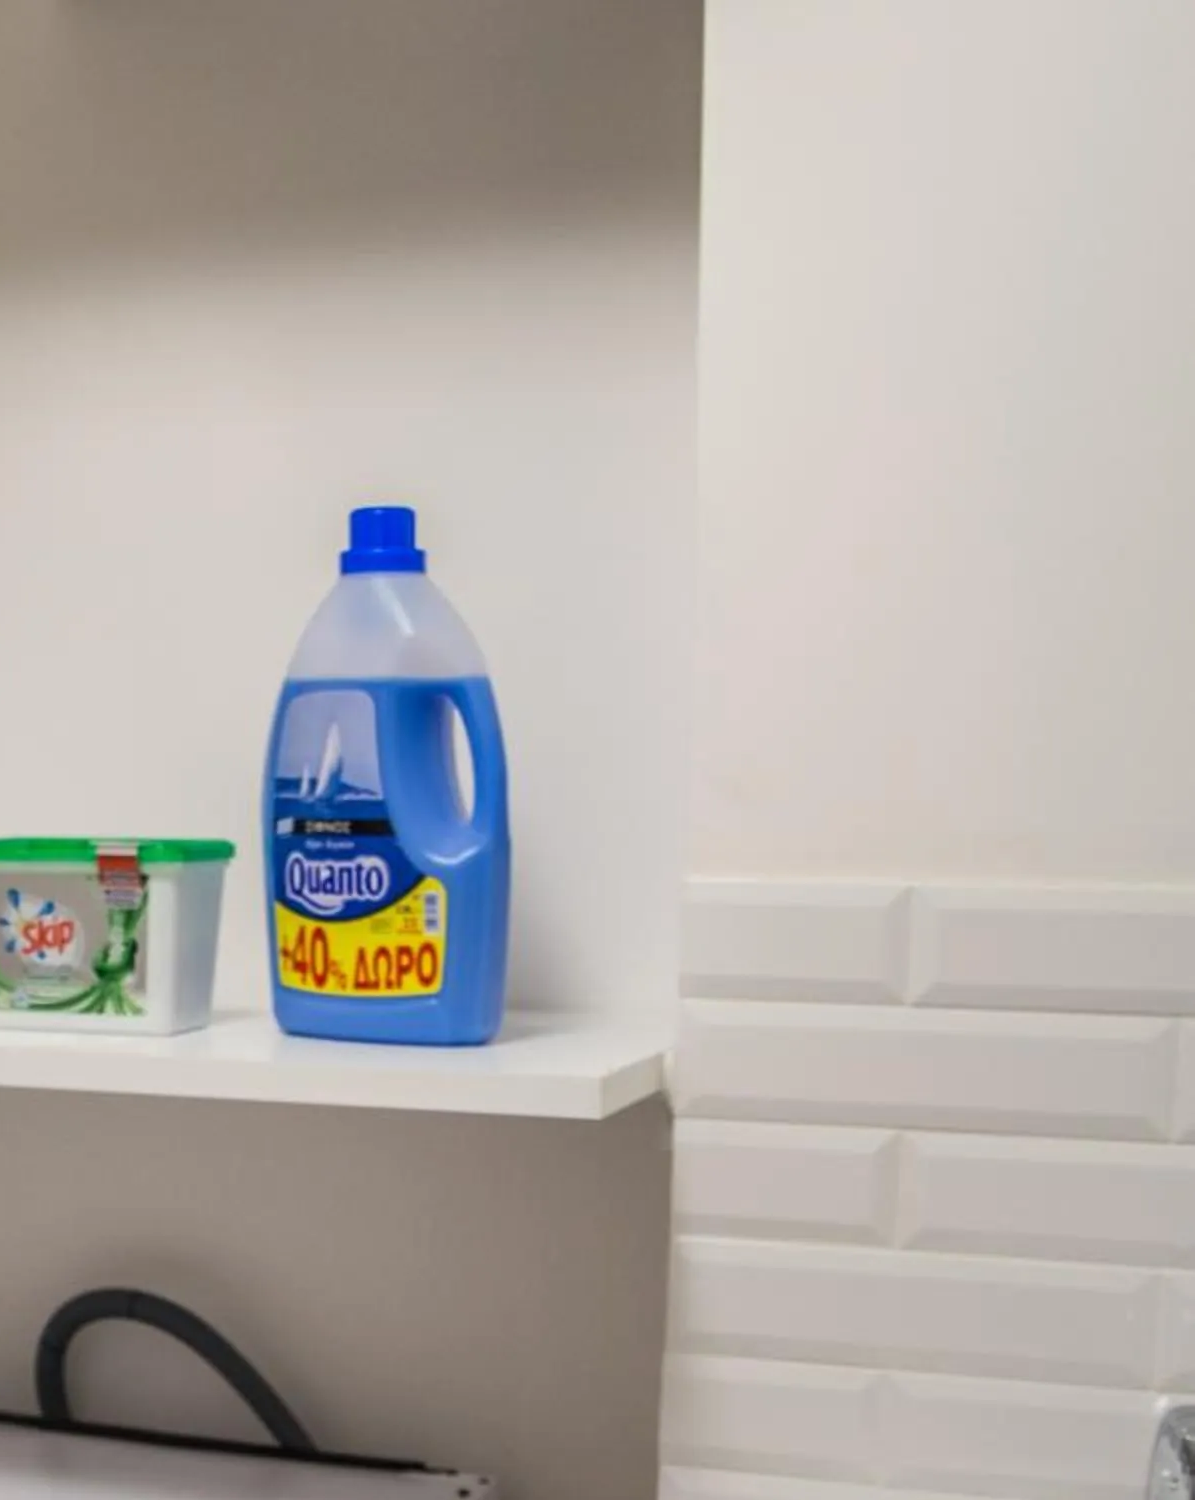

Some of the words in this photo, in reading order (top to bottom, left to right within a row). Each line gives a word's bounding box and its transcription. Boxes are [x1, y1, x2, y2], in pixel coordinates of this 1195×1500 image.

[287, 853, 388, 913] Quanto
[21, 918, 74, 954] Skip
[353, 942, 439, 990] ΔΩΡΟ
